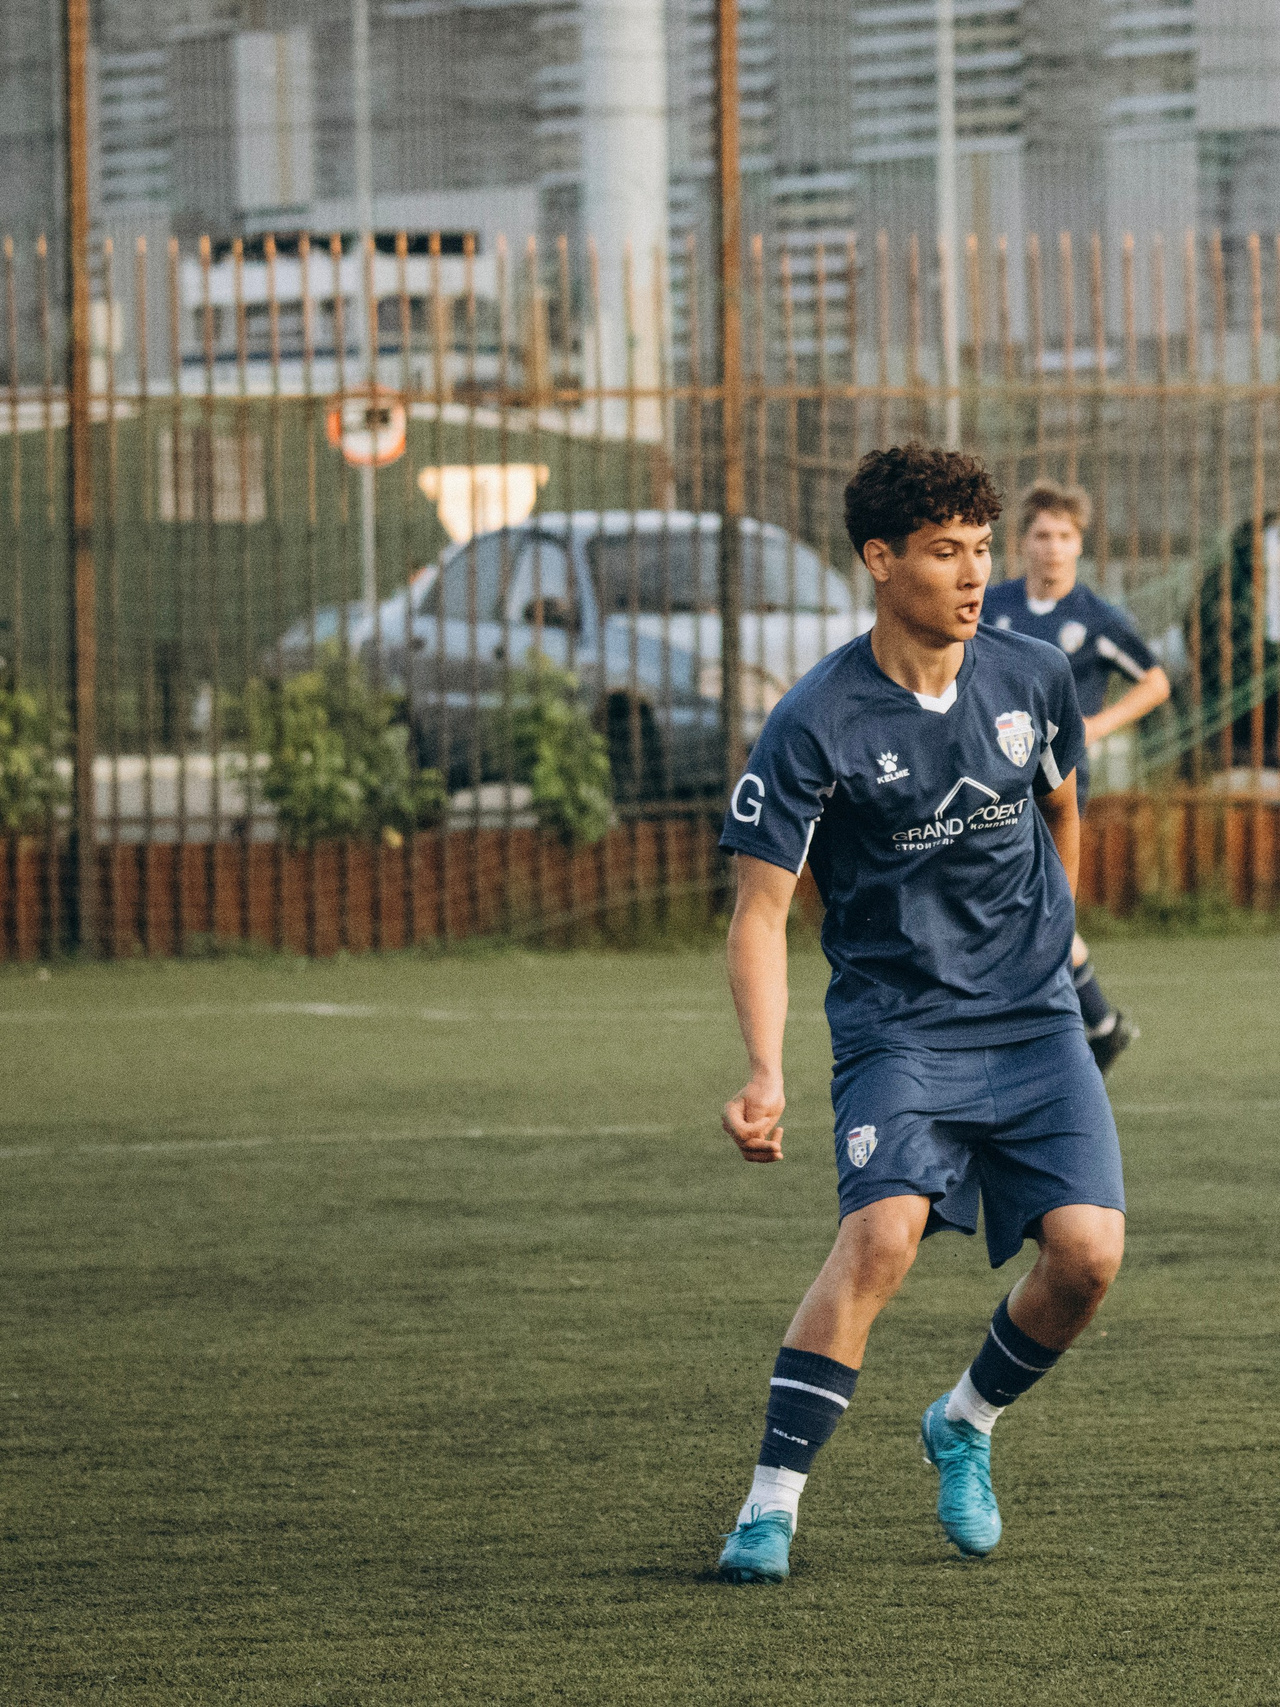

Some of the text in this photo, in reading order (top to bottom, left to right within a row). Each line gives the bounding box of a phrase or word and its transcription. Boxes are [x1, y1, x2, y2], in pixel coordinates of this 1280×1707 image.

[876, 768, 910, 784] KELME
[731, 773, 765, 826] G
[892, 818, 964, 841] GRAND
